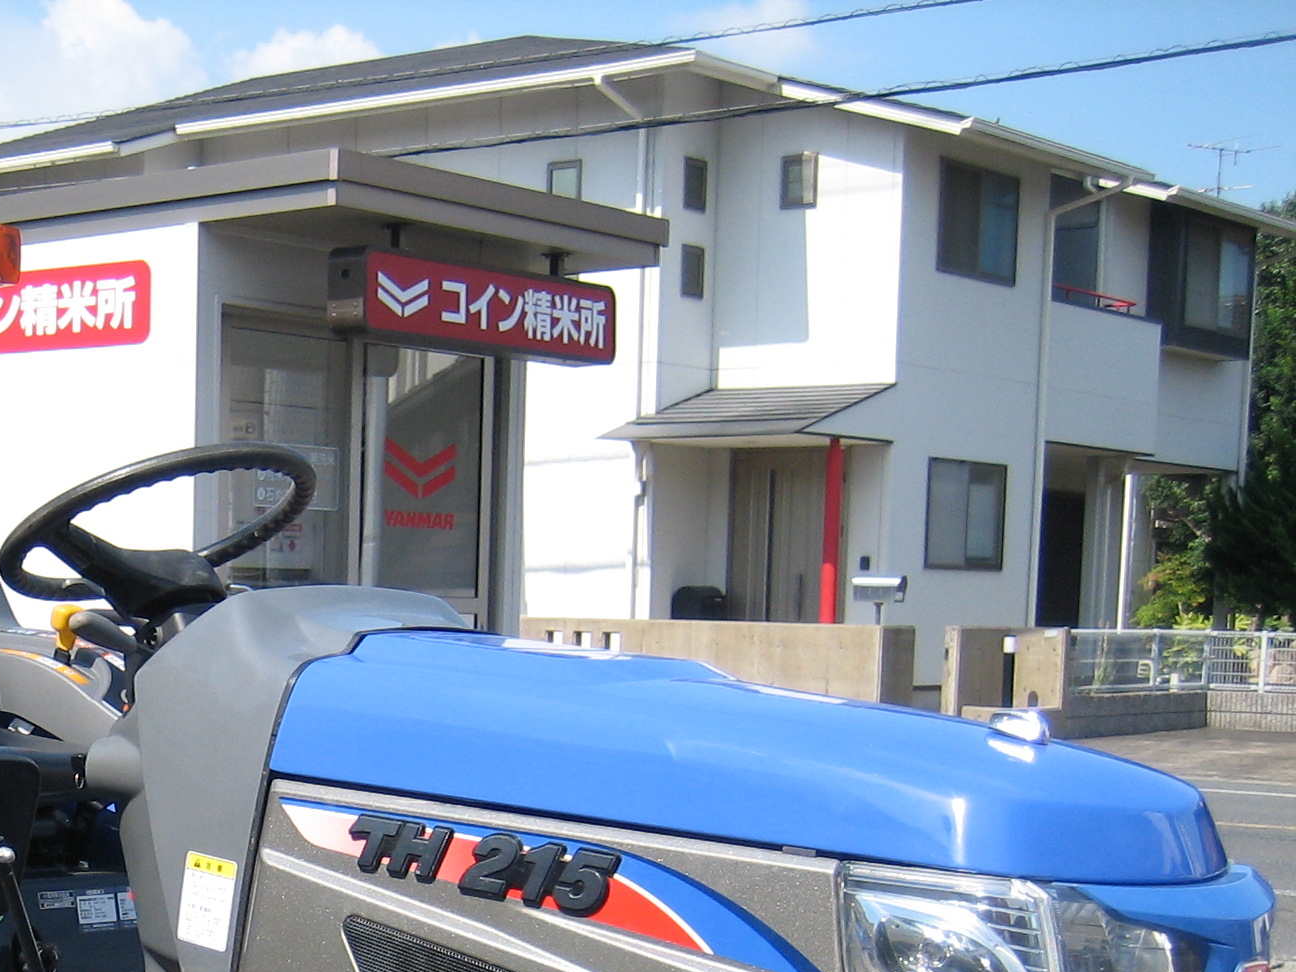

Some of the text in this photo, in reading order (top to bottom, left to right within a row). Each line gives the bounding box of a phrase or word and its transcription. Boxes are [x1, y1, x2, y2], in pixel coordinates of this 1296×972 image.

[440, 278, 608, 350] コイン精米所
[384, 509, 455, 530] YANMAR
[349, 813, 622, 917] TH 215
